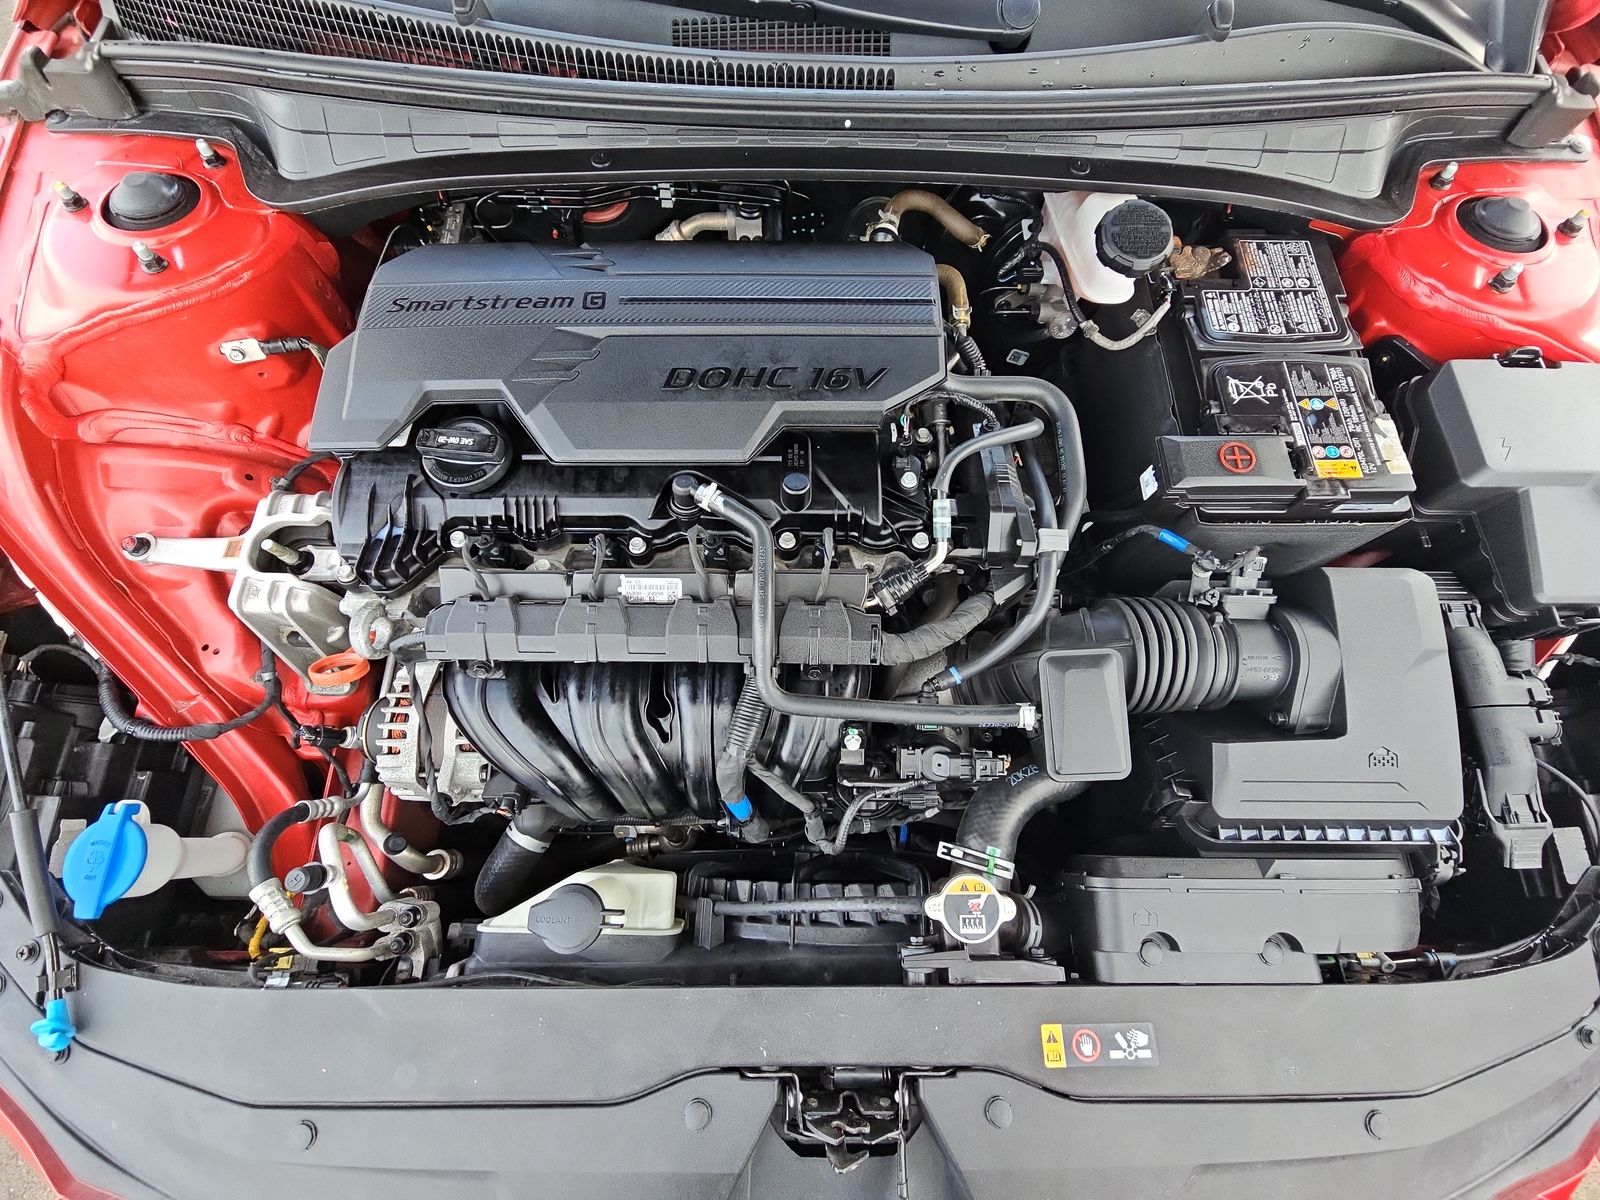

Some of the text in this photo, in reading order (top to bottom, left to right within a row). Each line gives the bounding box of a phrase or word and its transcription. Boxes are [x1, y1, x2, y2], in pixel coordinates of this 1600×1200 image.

[386, 294, 575, 313] Smartstream
[661, 366, 890, 391] DOHC 16V
[1265, 382, 1278, 397] Pb
[1333, 380, 1343, 392] CCA
[437, 435, 474, 446] SAE 0W-20
[1367, 462, 1377, 474] 12V
[1006, 764, 1039, 786] 20K28
[535, 915, 573, 925] COOLANT
